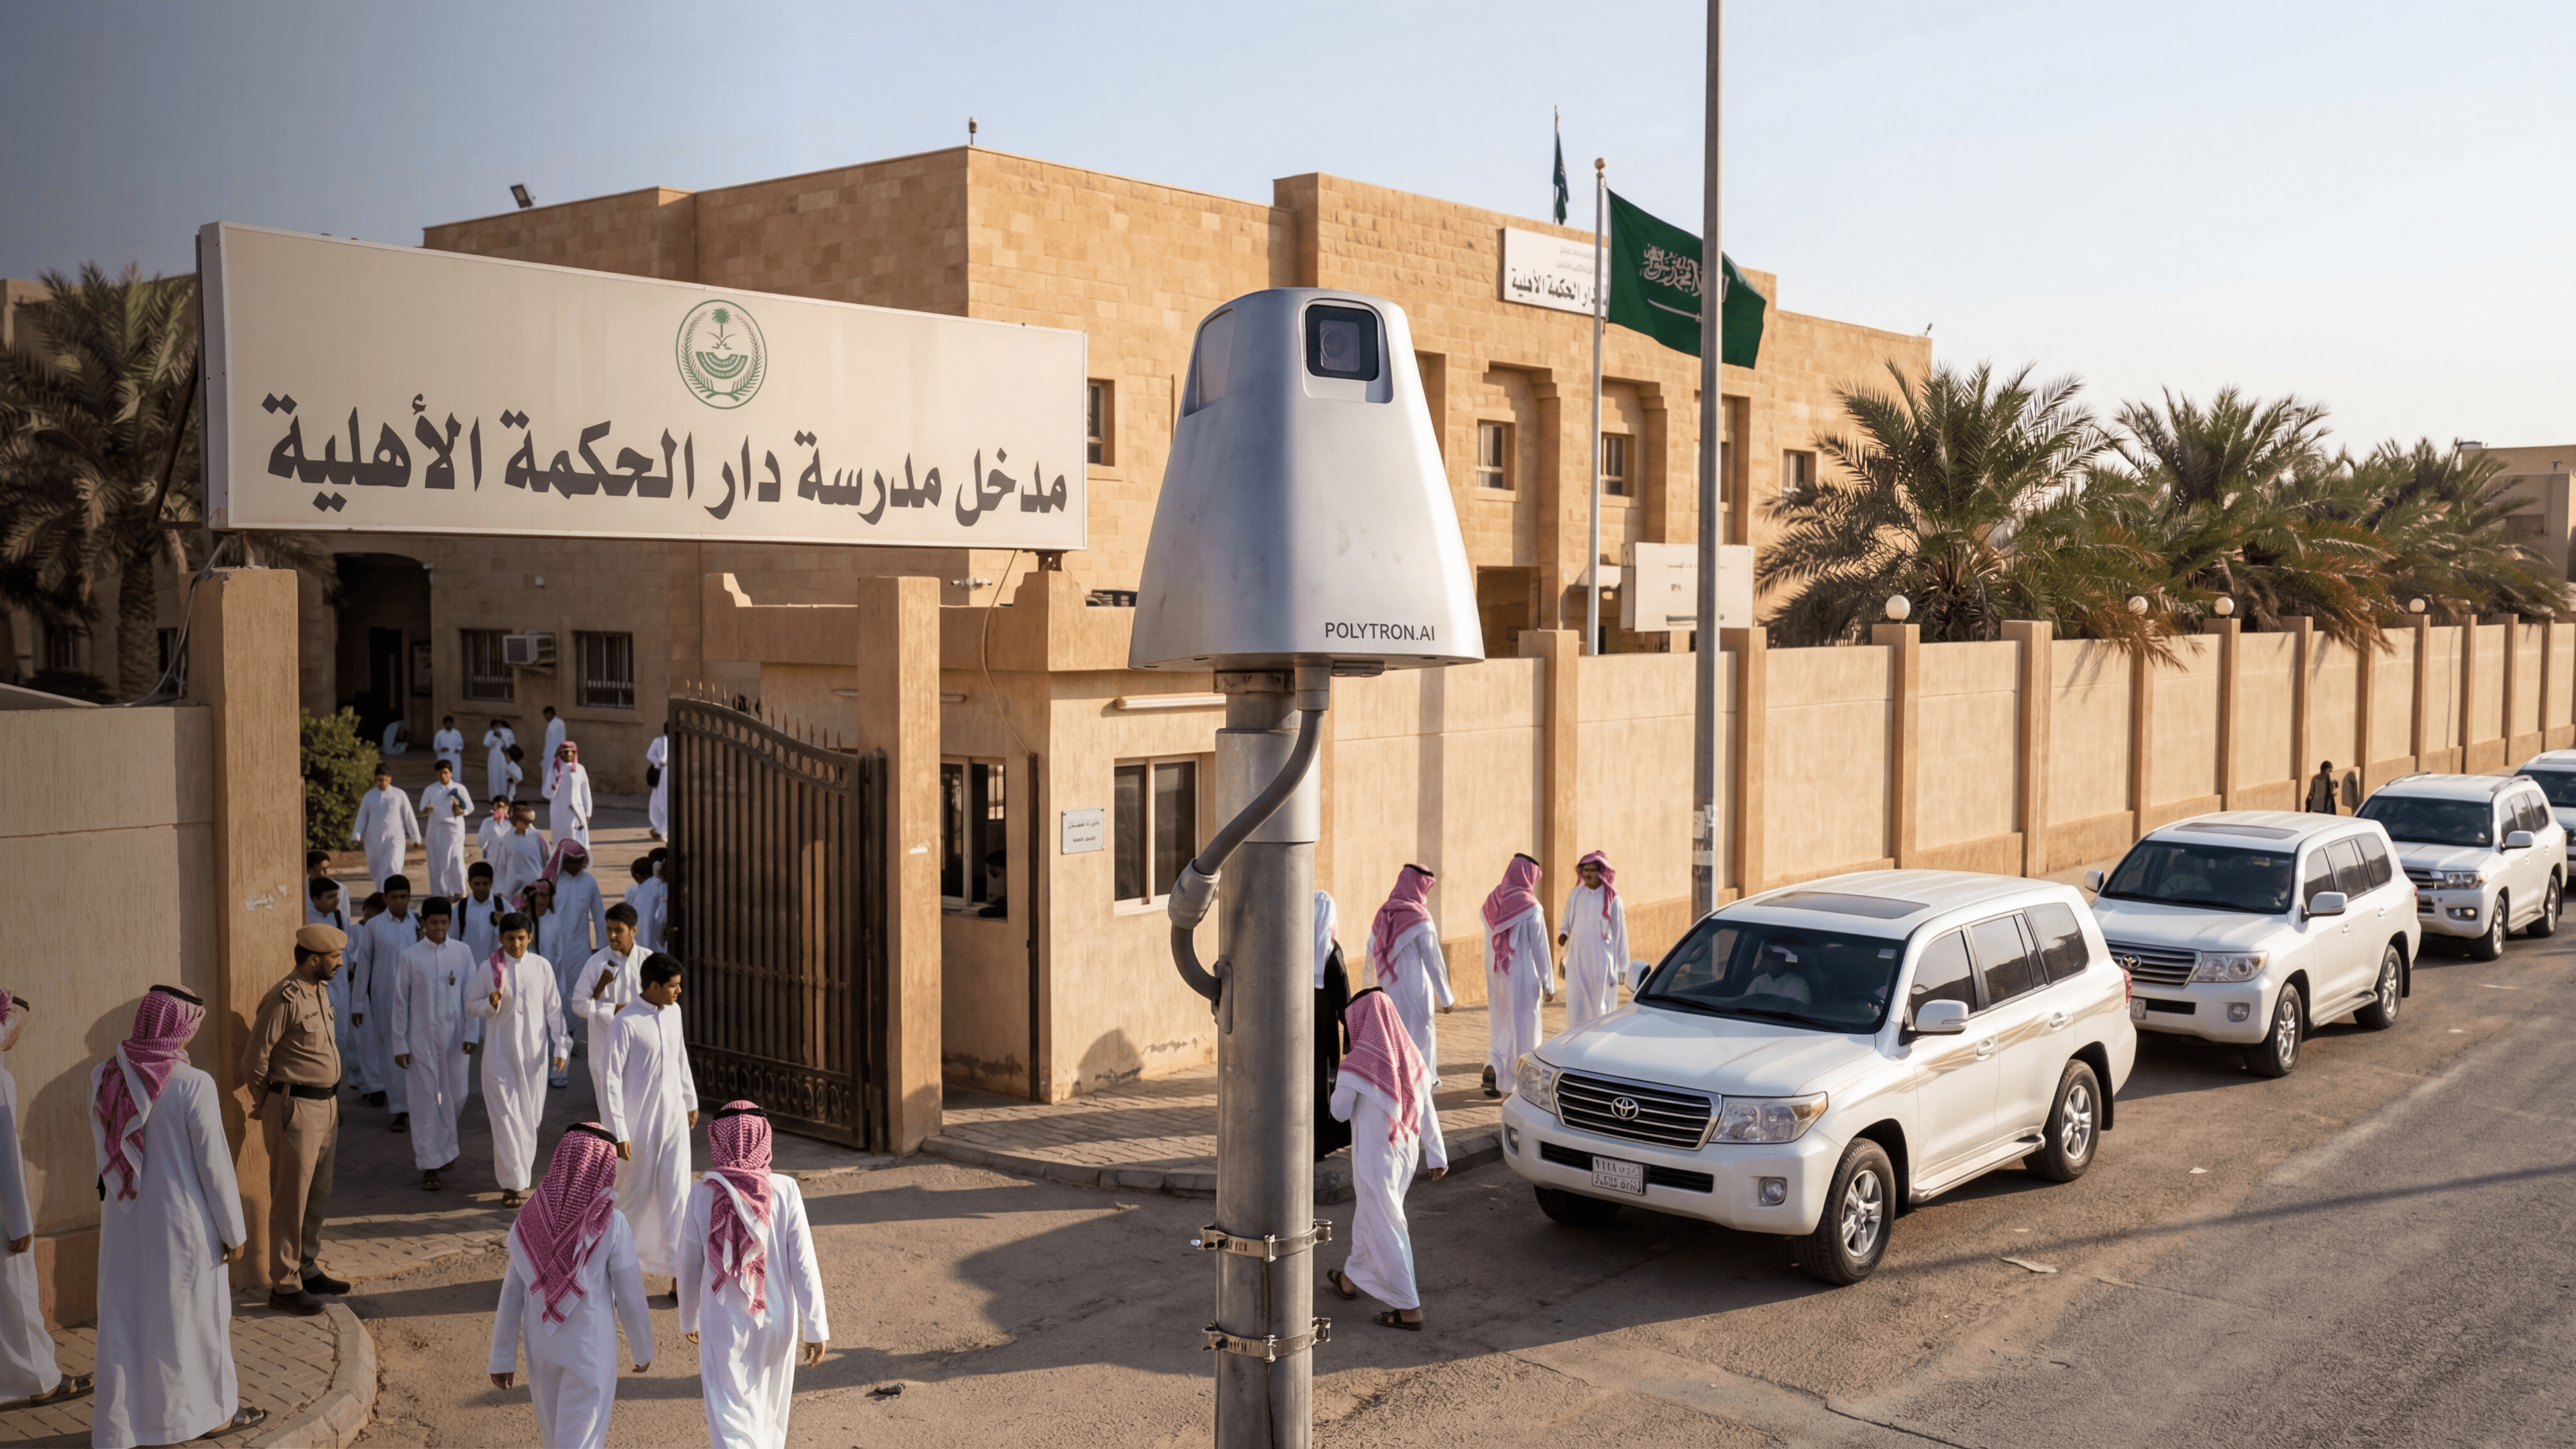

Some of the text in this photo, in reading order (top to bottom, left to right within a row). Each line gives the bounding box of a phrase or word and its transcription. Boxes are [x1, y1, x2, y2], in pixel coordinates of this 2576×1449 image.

[261, 392, 1067, 527] مدخل مدرسة دار الحكمة الأهلية
[1325, 622, 1435, 641] POLYTRON.AI
